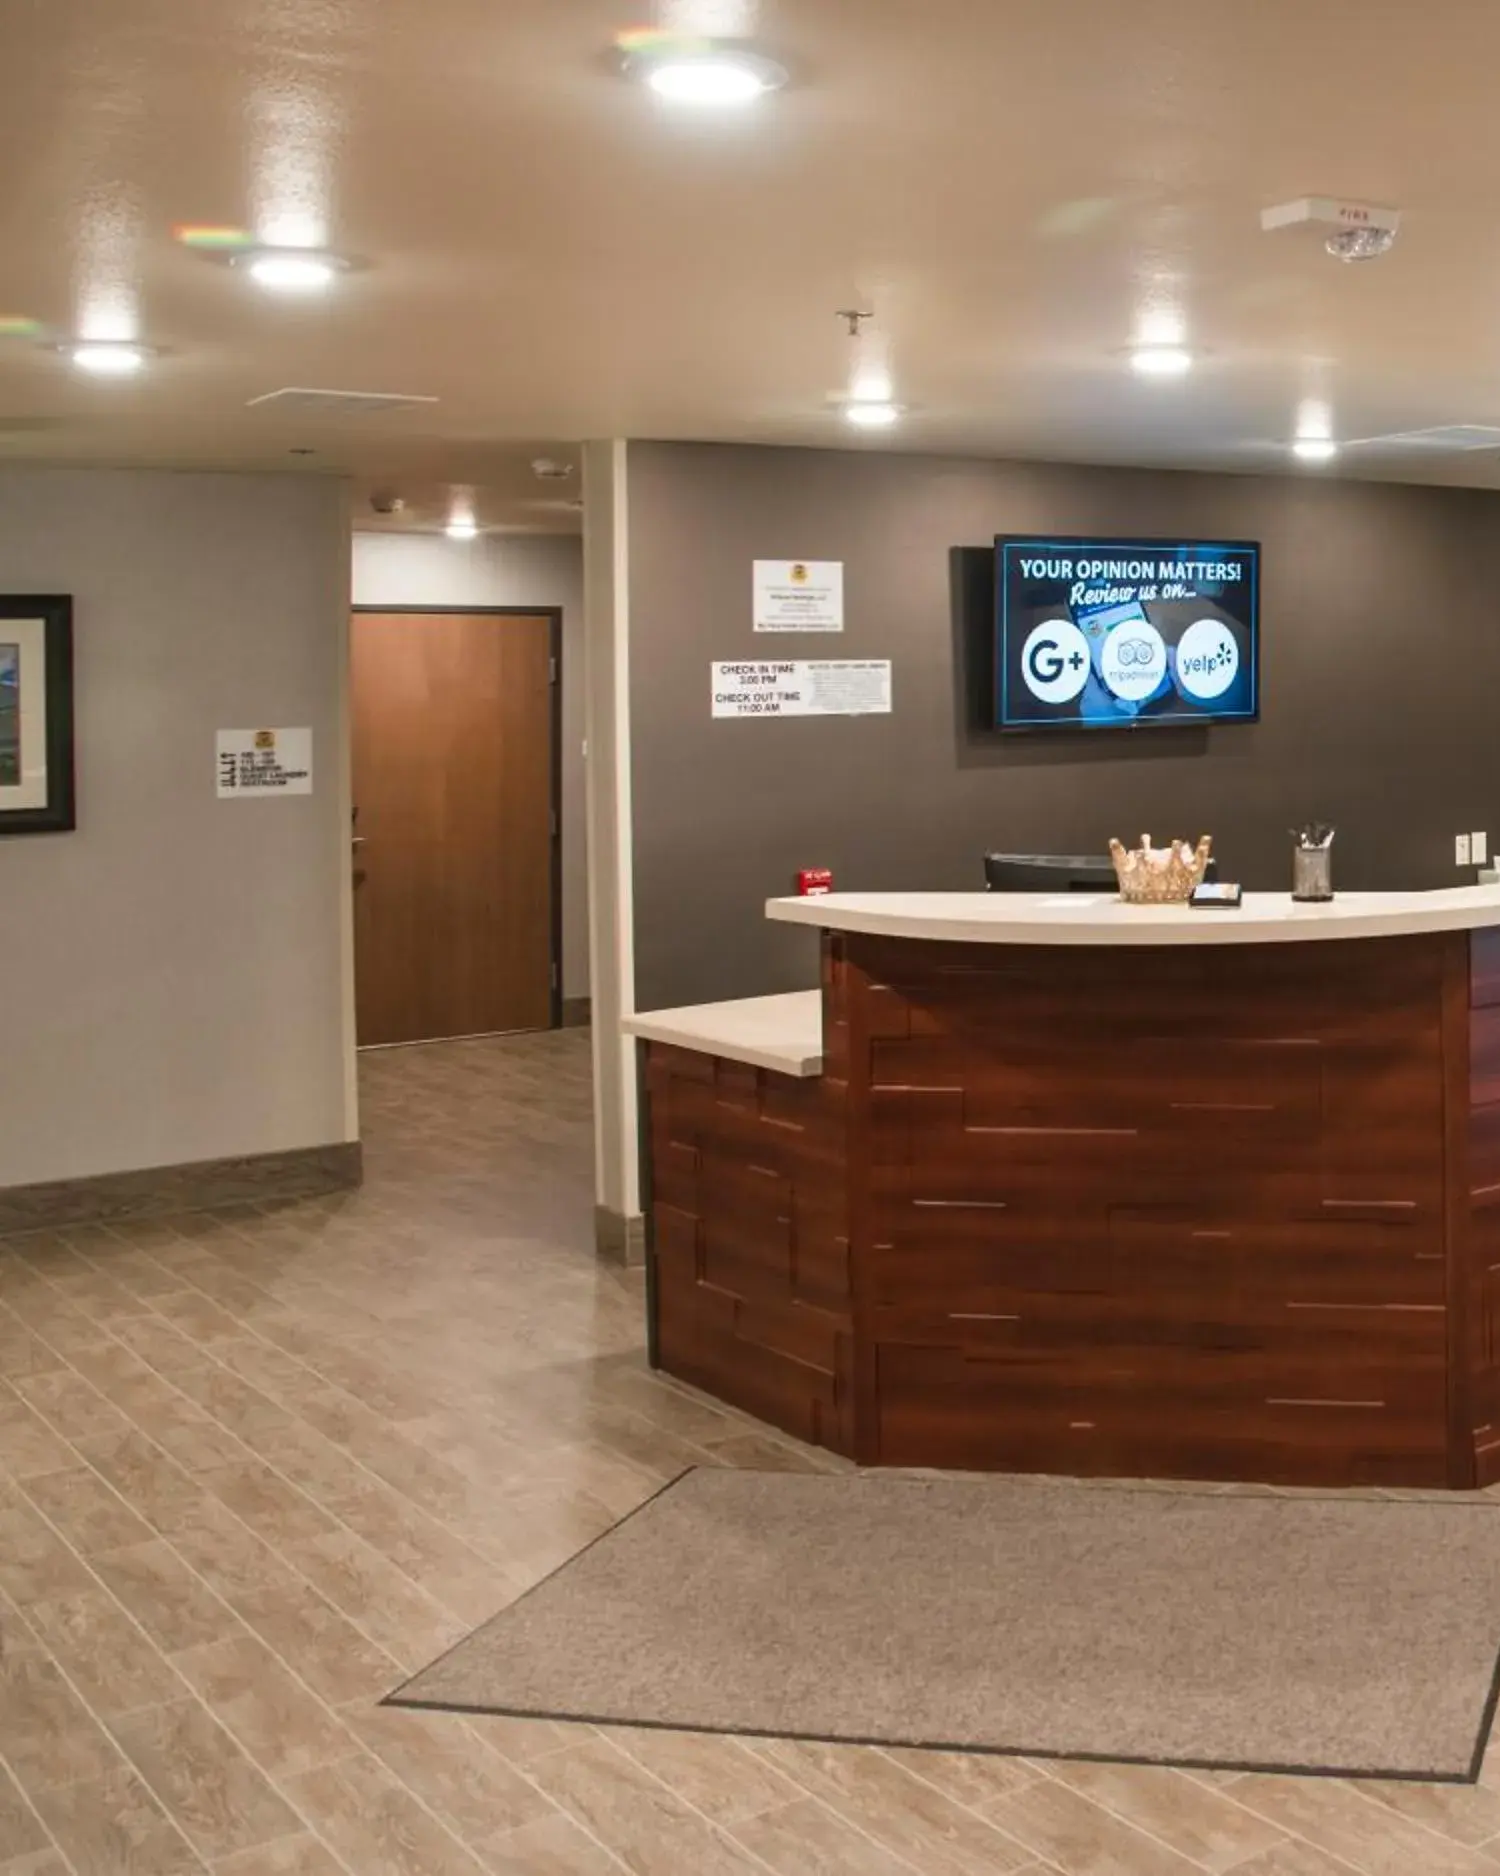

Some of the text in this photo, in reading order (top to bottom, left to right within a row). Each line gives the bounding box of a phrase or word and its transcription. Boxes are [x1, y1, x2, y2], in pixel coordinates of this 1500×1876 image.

[1020, 559, 1241, 581] YOUR OPINION MATTERS!
[1069, 582, 1136, 606] Review
[1138, 585, 1157, 600] us
[720, 664, 756, 675] CHECK
[758, 664, 768, 675] IN
[771, 663, 796, 674] TIME
[1183, 652, 1218, 675] yelp
[739, 675, 777, 685] 3:00 PM
[715, 691, 801, 703] CHECK OUT TIME
[737, 703, 781, 714] 11:00 AM
